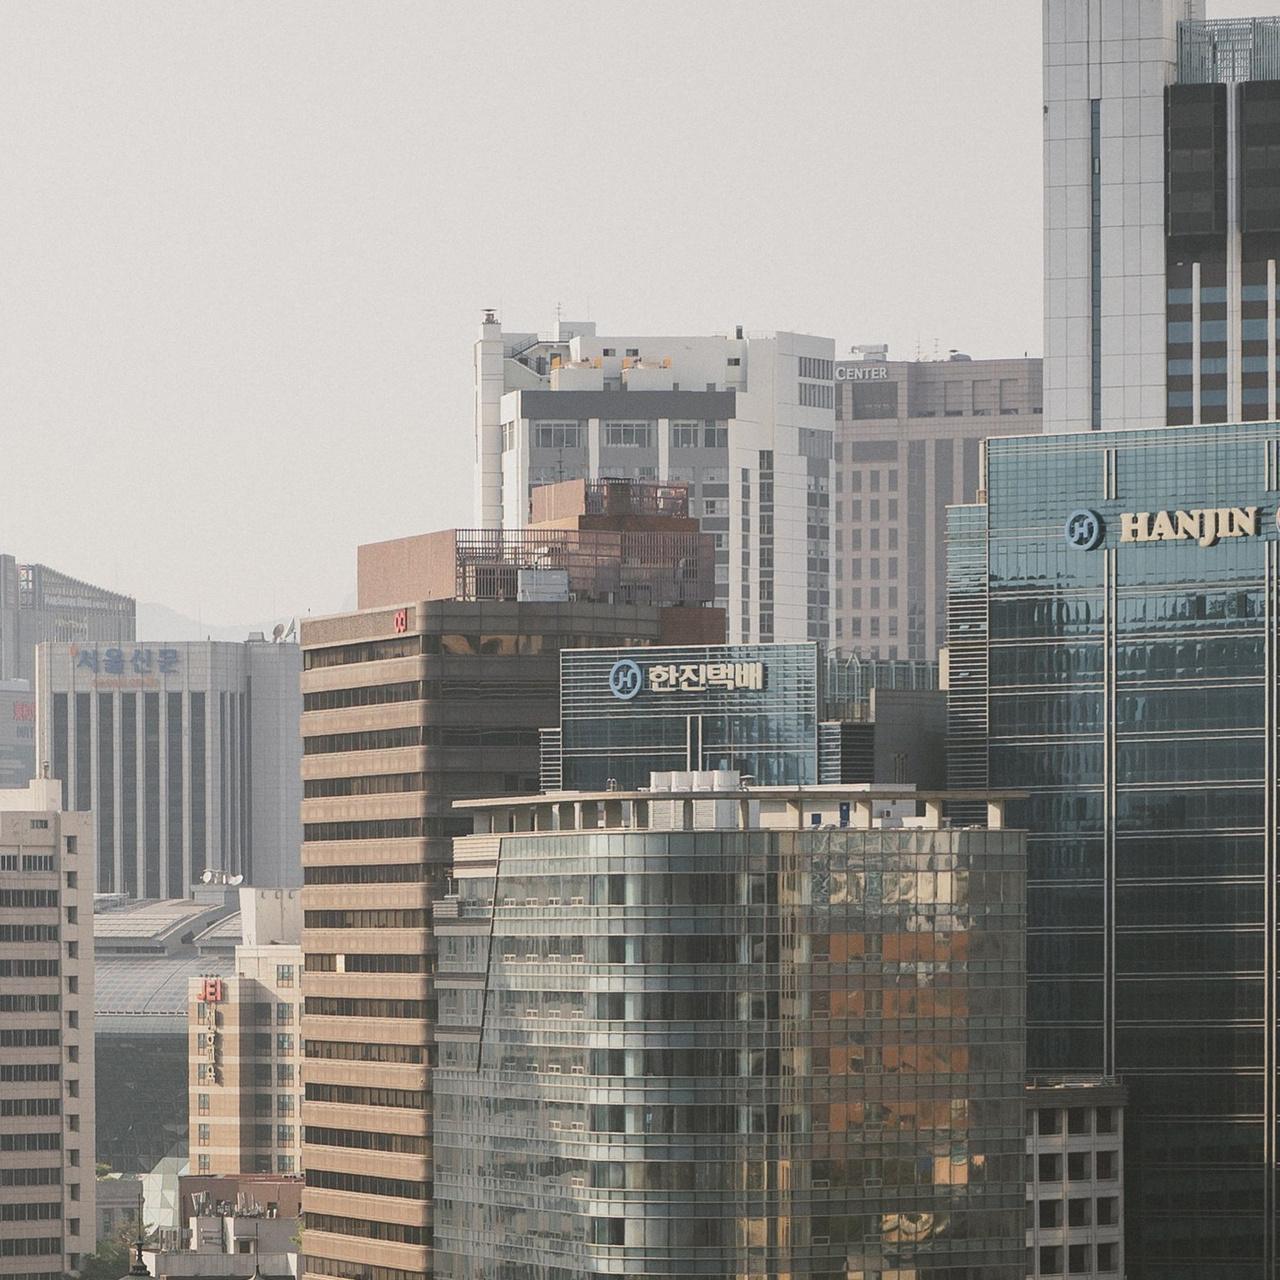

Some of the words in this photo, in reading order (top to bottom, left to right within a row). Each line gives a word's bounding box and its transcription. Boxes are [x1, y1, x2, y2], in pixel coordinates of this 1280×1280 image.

[835, 366, 888, 381] CENTER
[1120, 506, 1258, 547] HANJIN
[77, 648, 181, 674] 서울신문
[649, 662, 764, 692] 한진택배
[197, 980, 222, 1001] JEI
